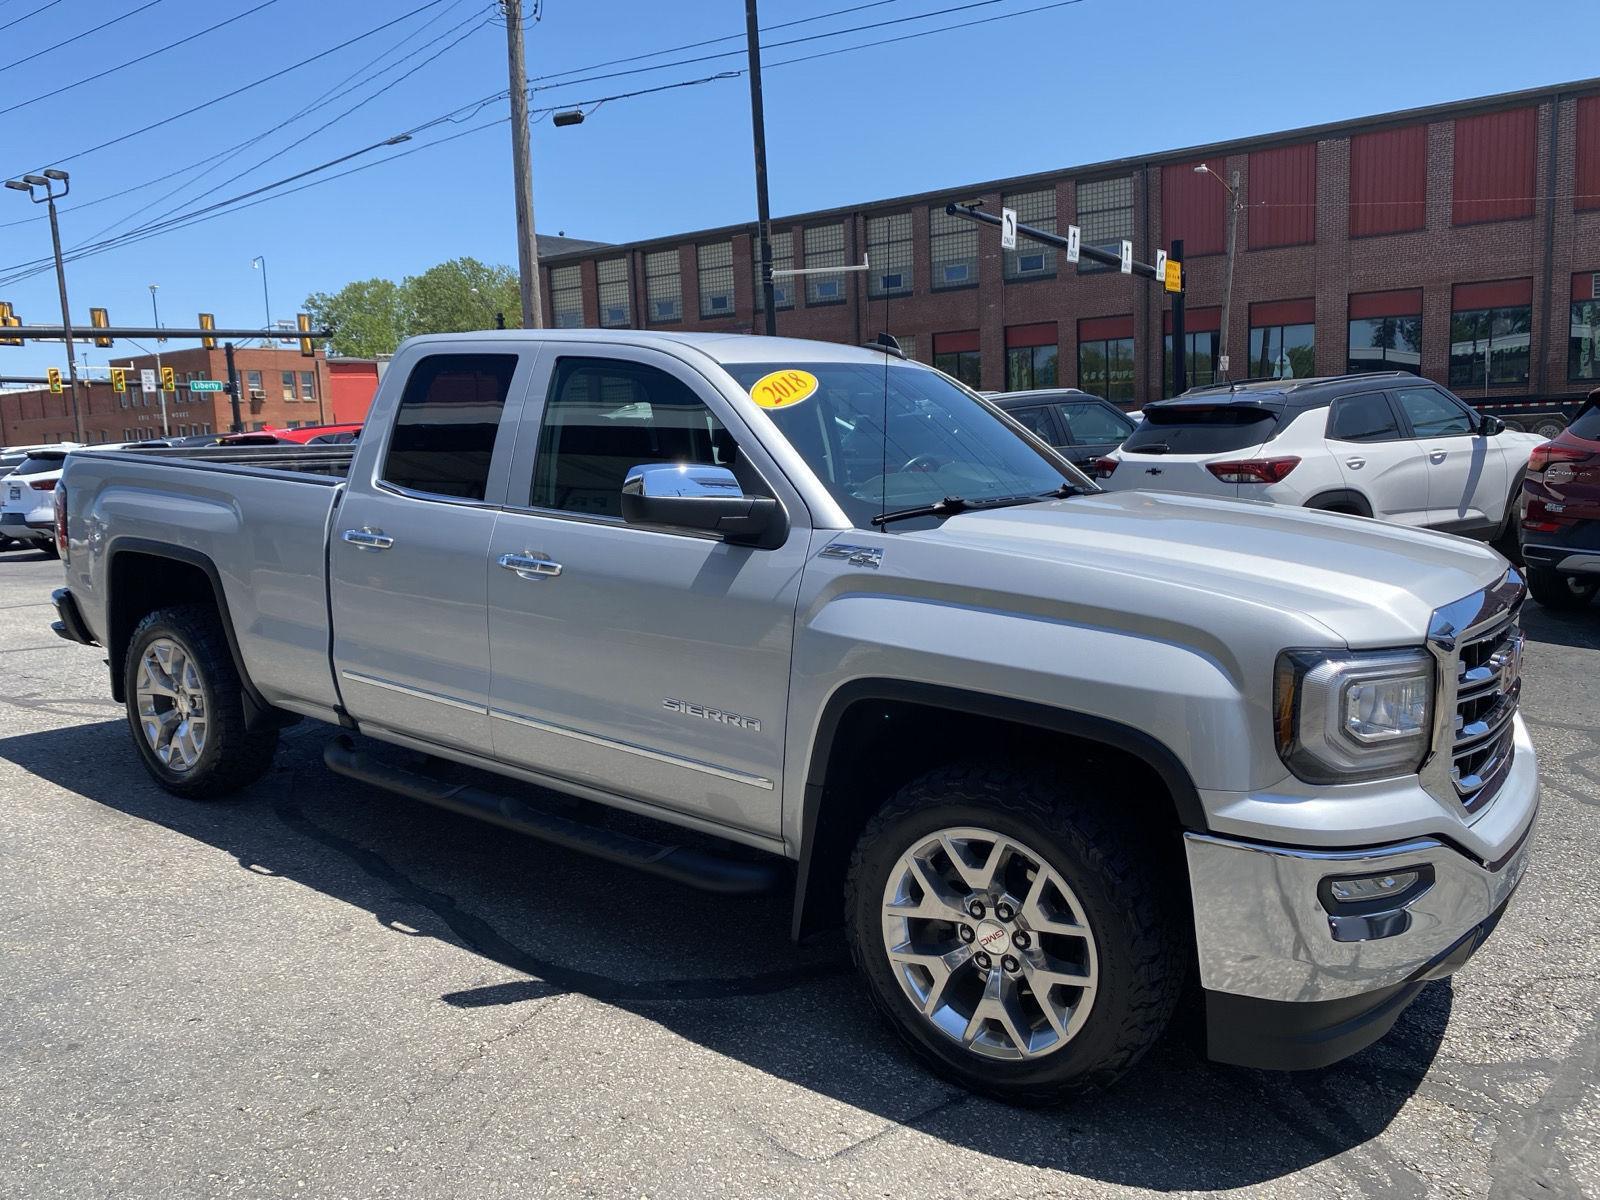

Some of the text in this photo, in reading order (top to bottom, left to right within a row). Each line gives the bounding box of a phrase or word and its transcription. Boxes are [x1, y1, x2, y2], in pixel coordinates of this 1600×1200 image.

[1003, 236, 1014, 246] ONLY
[194, 382, 219, 391] Liberty
[762, 372, 808, 405] 2018
[662, 697, 762, 732] SIERRA
[980, 929, 1005, 946] GMC
